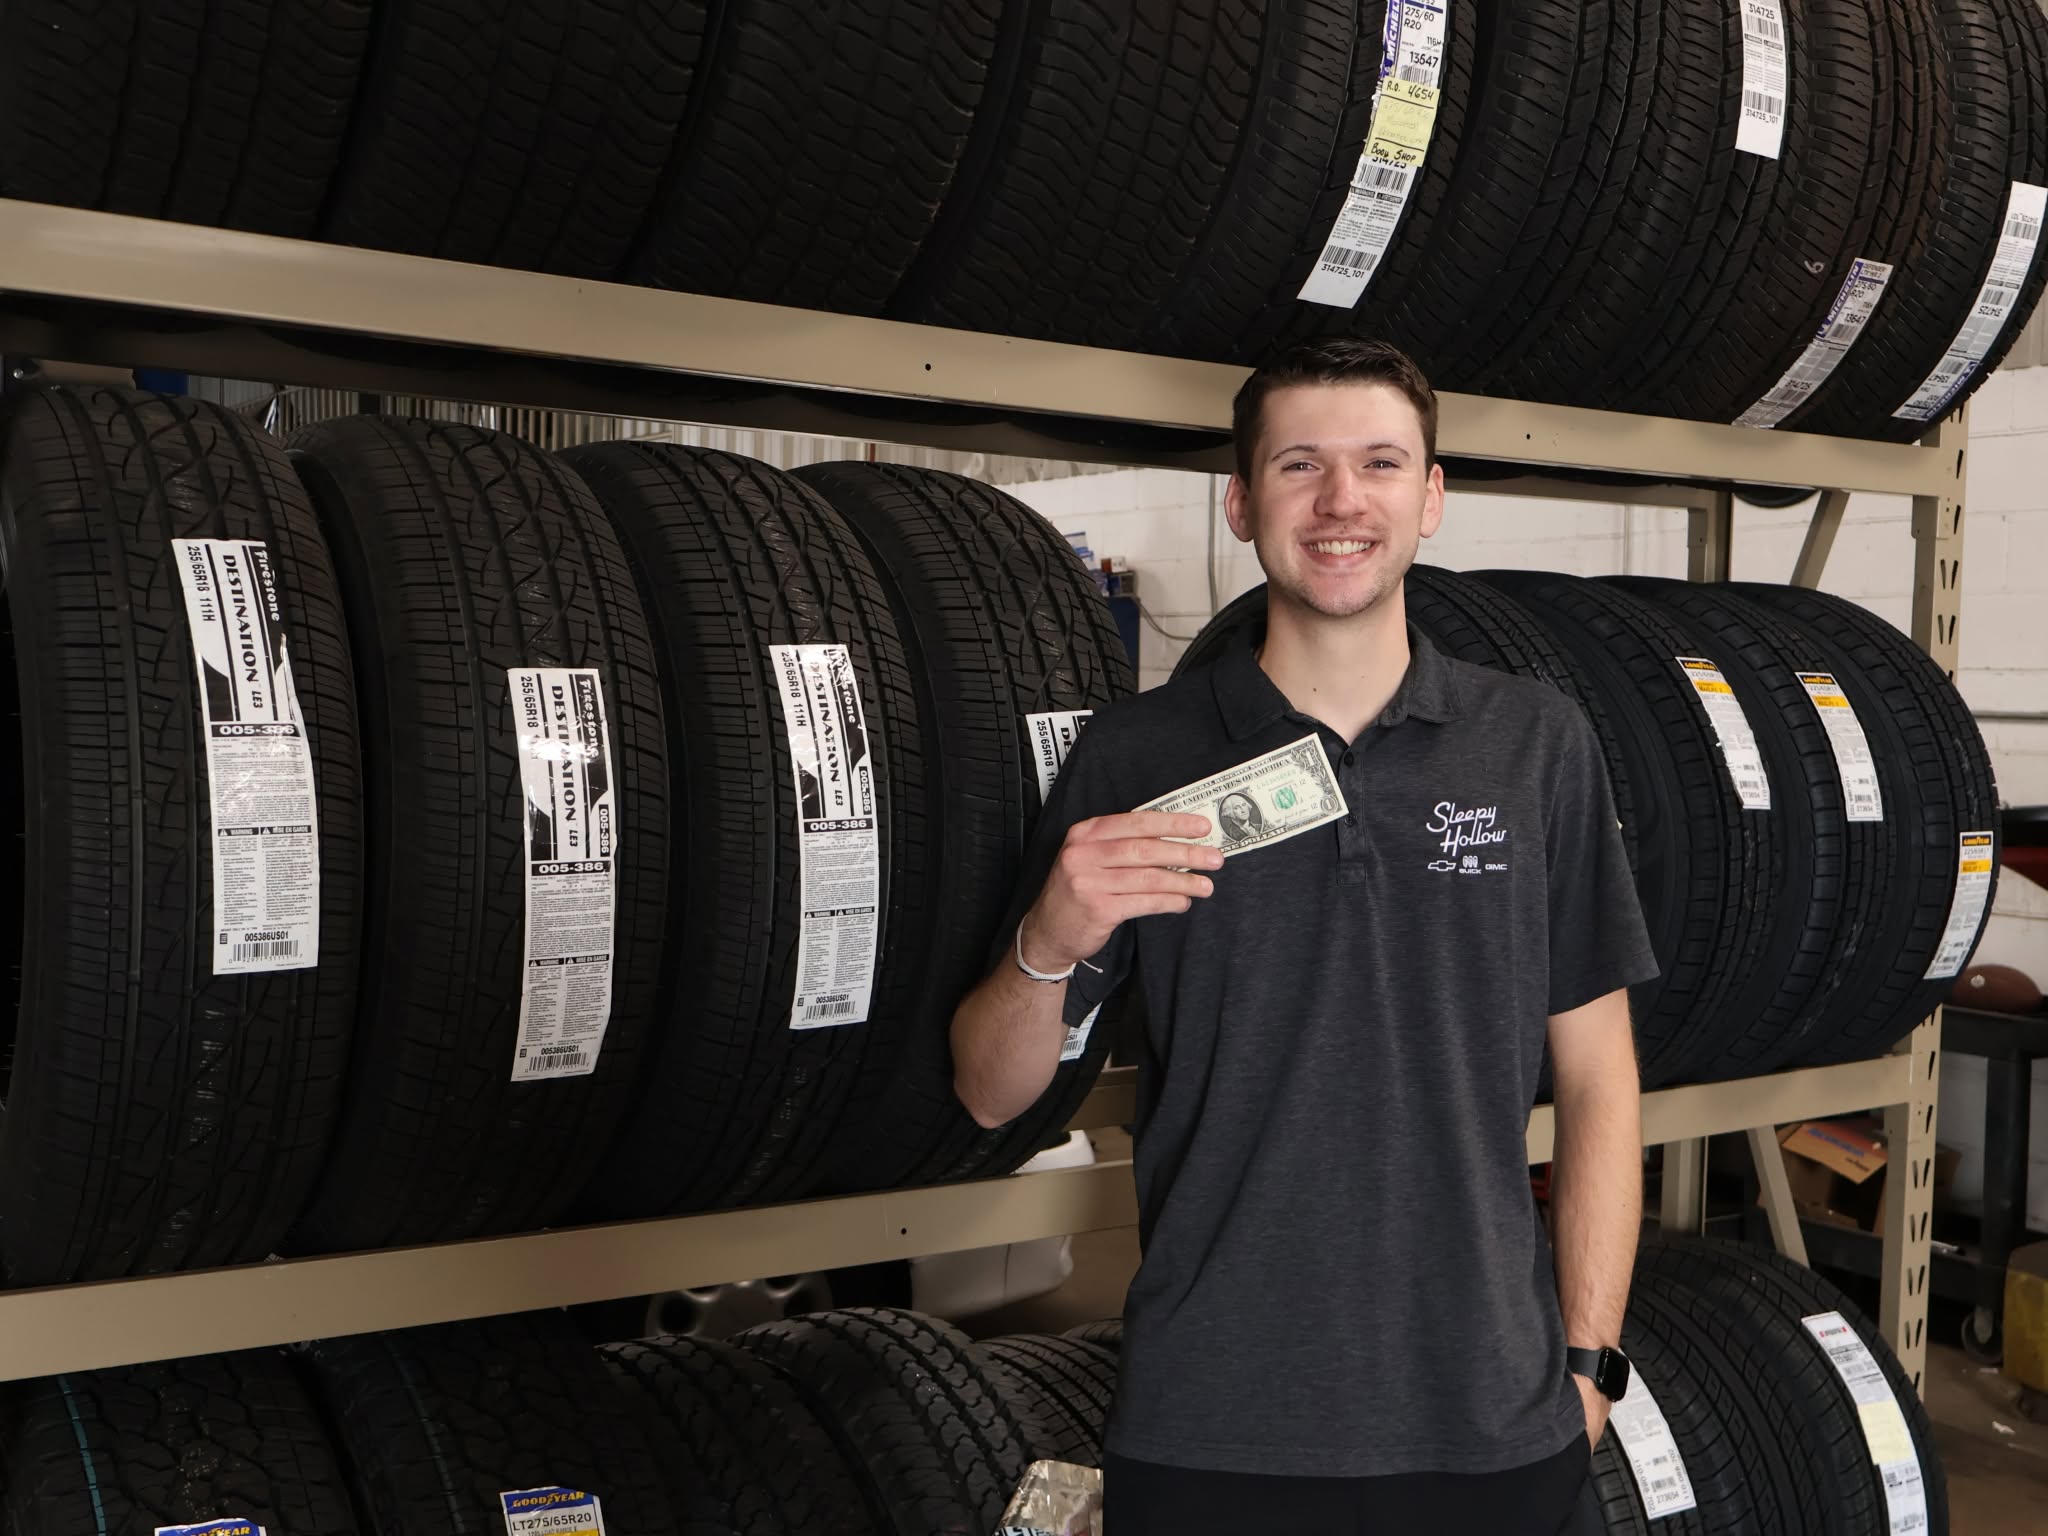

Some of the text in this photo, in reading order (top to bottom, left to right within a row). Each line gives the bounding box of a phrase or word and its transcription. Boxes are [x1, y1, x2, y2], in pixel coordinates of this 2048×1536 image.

[1405, 6, 1435, 22] 275/60
[1748, 3, 1775, 20] 314725
[1404, 18, 1422, 30] R20
[1410, 51, 1439, 68] 13647
[1408, 84, 1434, 101] 4654
[1321, 263, 1365, 279] 314725_101
[1827, 264, 1860, 322] MICHELIN
[187, 546, 216, 621] 255/65R18 111H
[254, 550, 280, 622] Firestone
[223, 554, 263, 708] DESTINATION LE3
[781, 651, 807, 727] 255/65R18 111H
[521, 676, 539, 728] 255/65R18
[1037, 720, 1054, 766] 255/65R18
[1165, 800, 1182, 813] THE
[1183, 787, 1212, 807] UNITED
[1212, 777, 1241, 796] STATES
[1252, 759, 1290, 781] AMERICA
[835, 790, 843, 806] LE3
[810, 820, 867, 831] 005-386
[1426, 802, 1496, 832] Sleepy
[569, 830, 578, 847] LE3
[600, 808, 609, 854] 005-386
[1241, 827, 1286, 848] DOLLAR
[1440, 822, 1507, 856] Hollow
[539, 862, 604, 874] 005-386
[244, 931, 289, 942] 005386US01
[816, 994, 849, 1004] 005386US01
[541, 1045, 579, 1055] 005386US01
[512, 1491, 585, 1507] GOODYEAR
[512, 1512, 592, 1531] LT275/65R20
